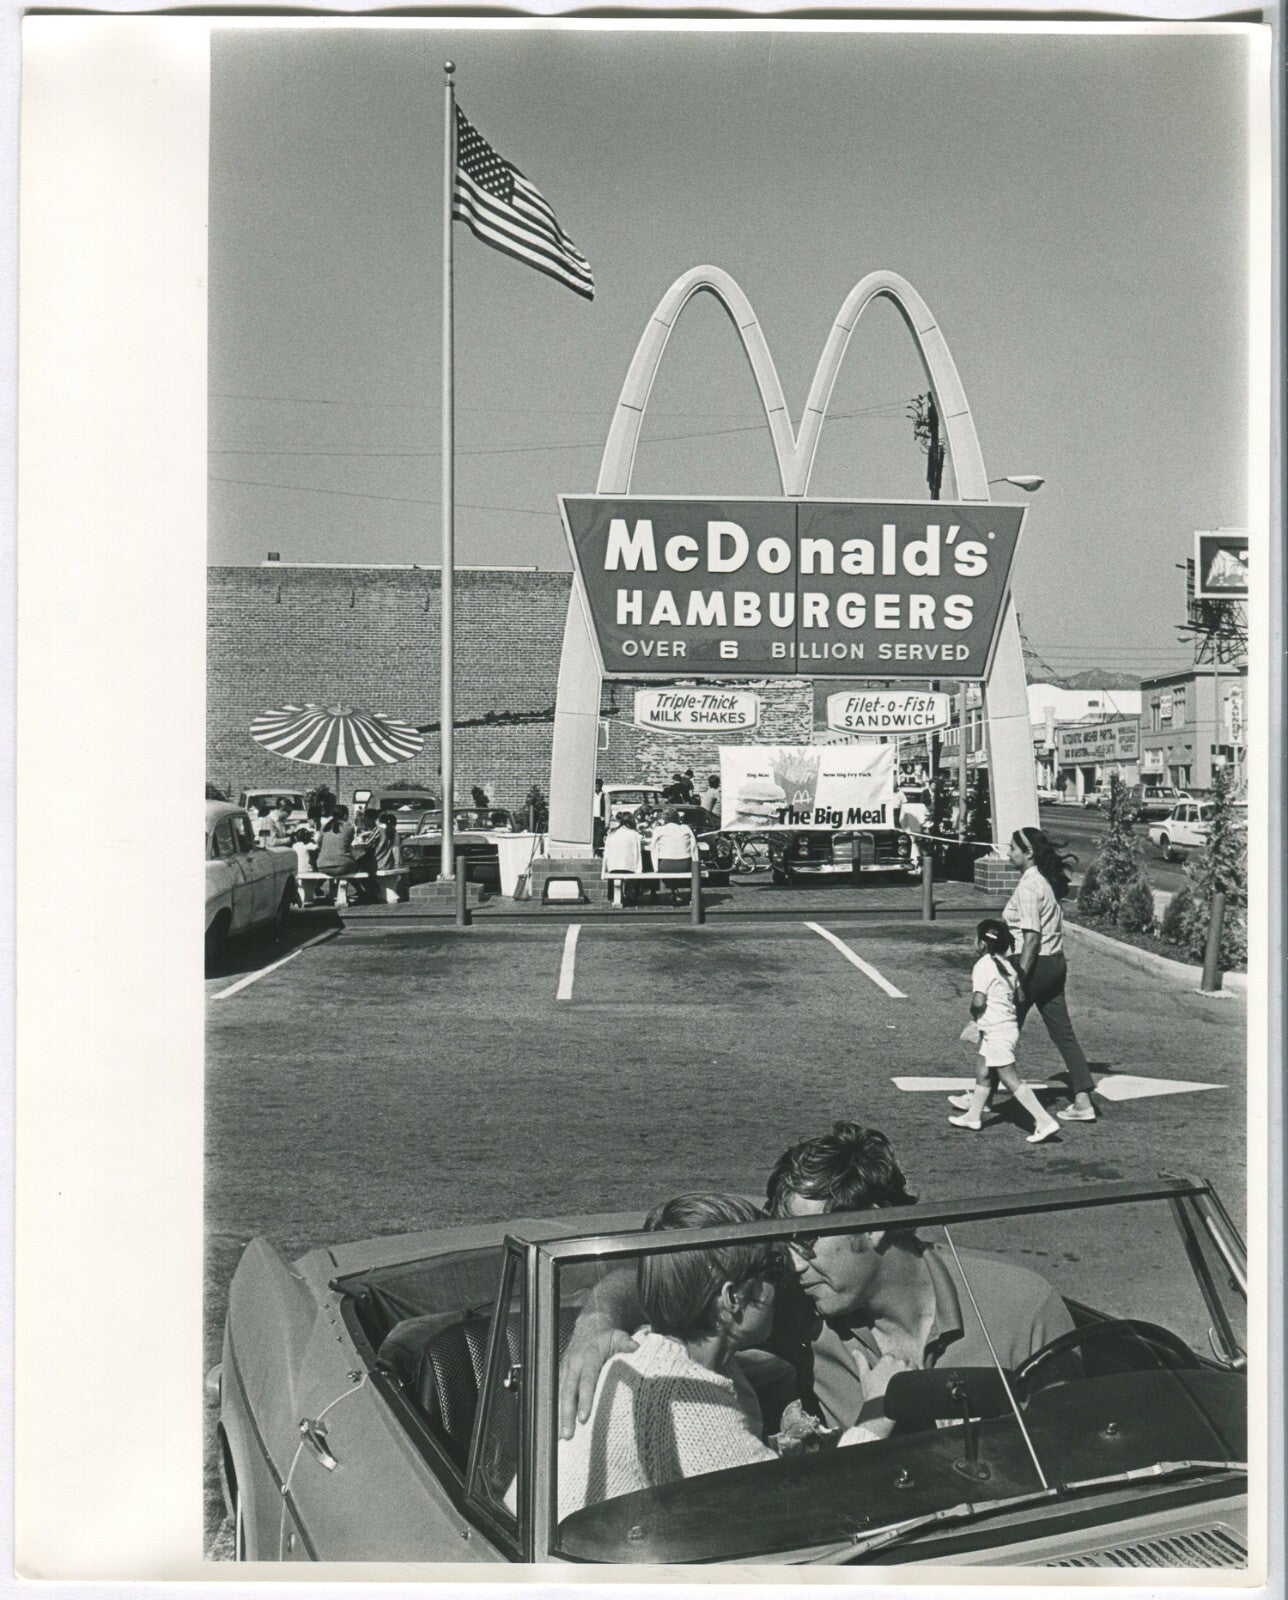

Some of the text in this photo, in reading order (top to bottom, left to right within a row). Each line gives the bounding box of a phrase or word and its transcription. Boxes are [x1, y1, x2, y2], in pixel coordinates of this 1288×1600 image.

[603, 518, 988, 577] McDonald's
[615, 588, 975, 631] HAMBURGERS
[621, 639, 970, 661] OVER 6 BILLION SERVED
[656, 693, 738, 710] Triple-Thick
[650, 710, 746, 724] MILK SHAKES
[844, 714, 936, 727] SANDWICH
[776, 803, 887, 829] The Big Meal
